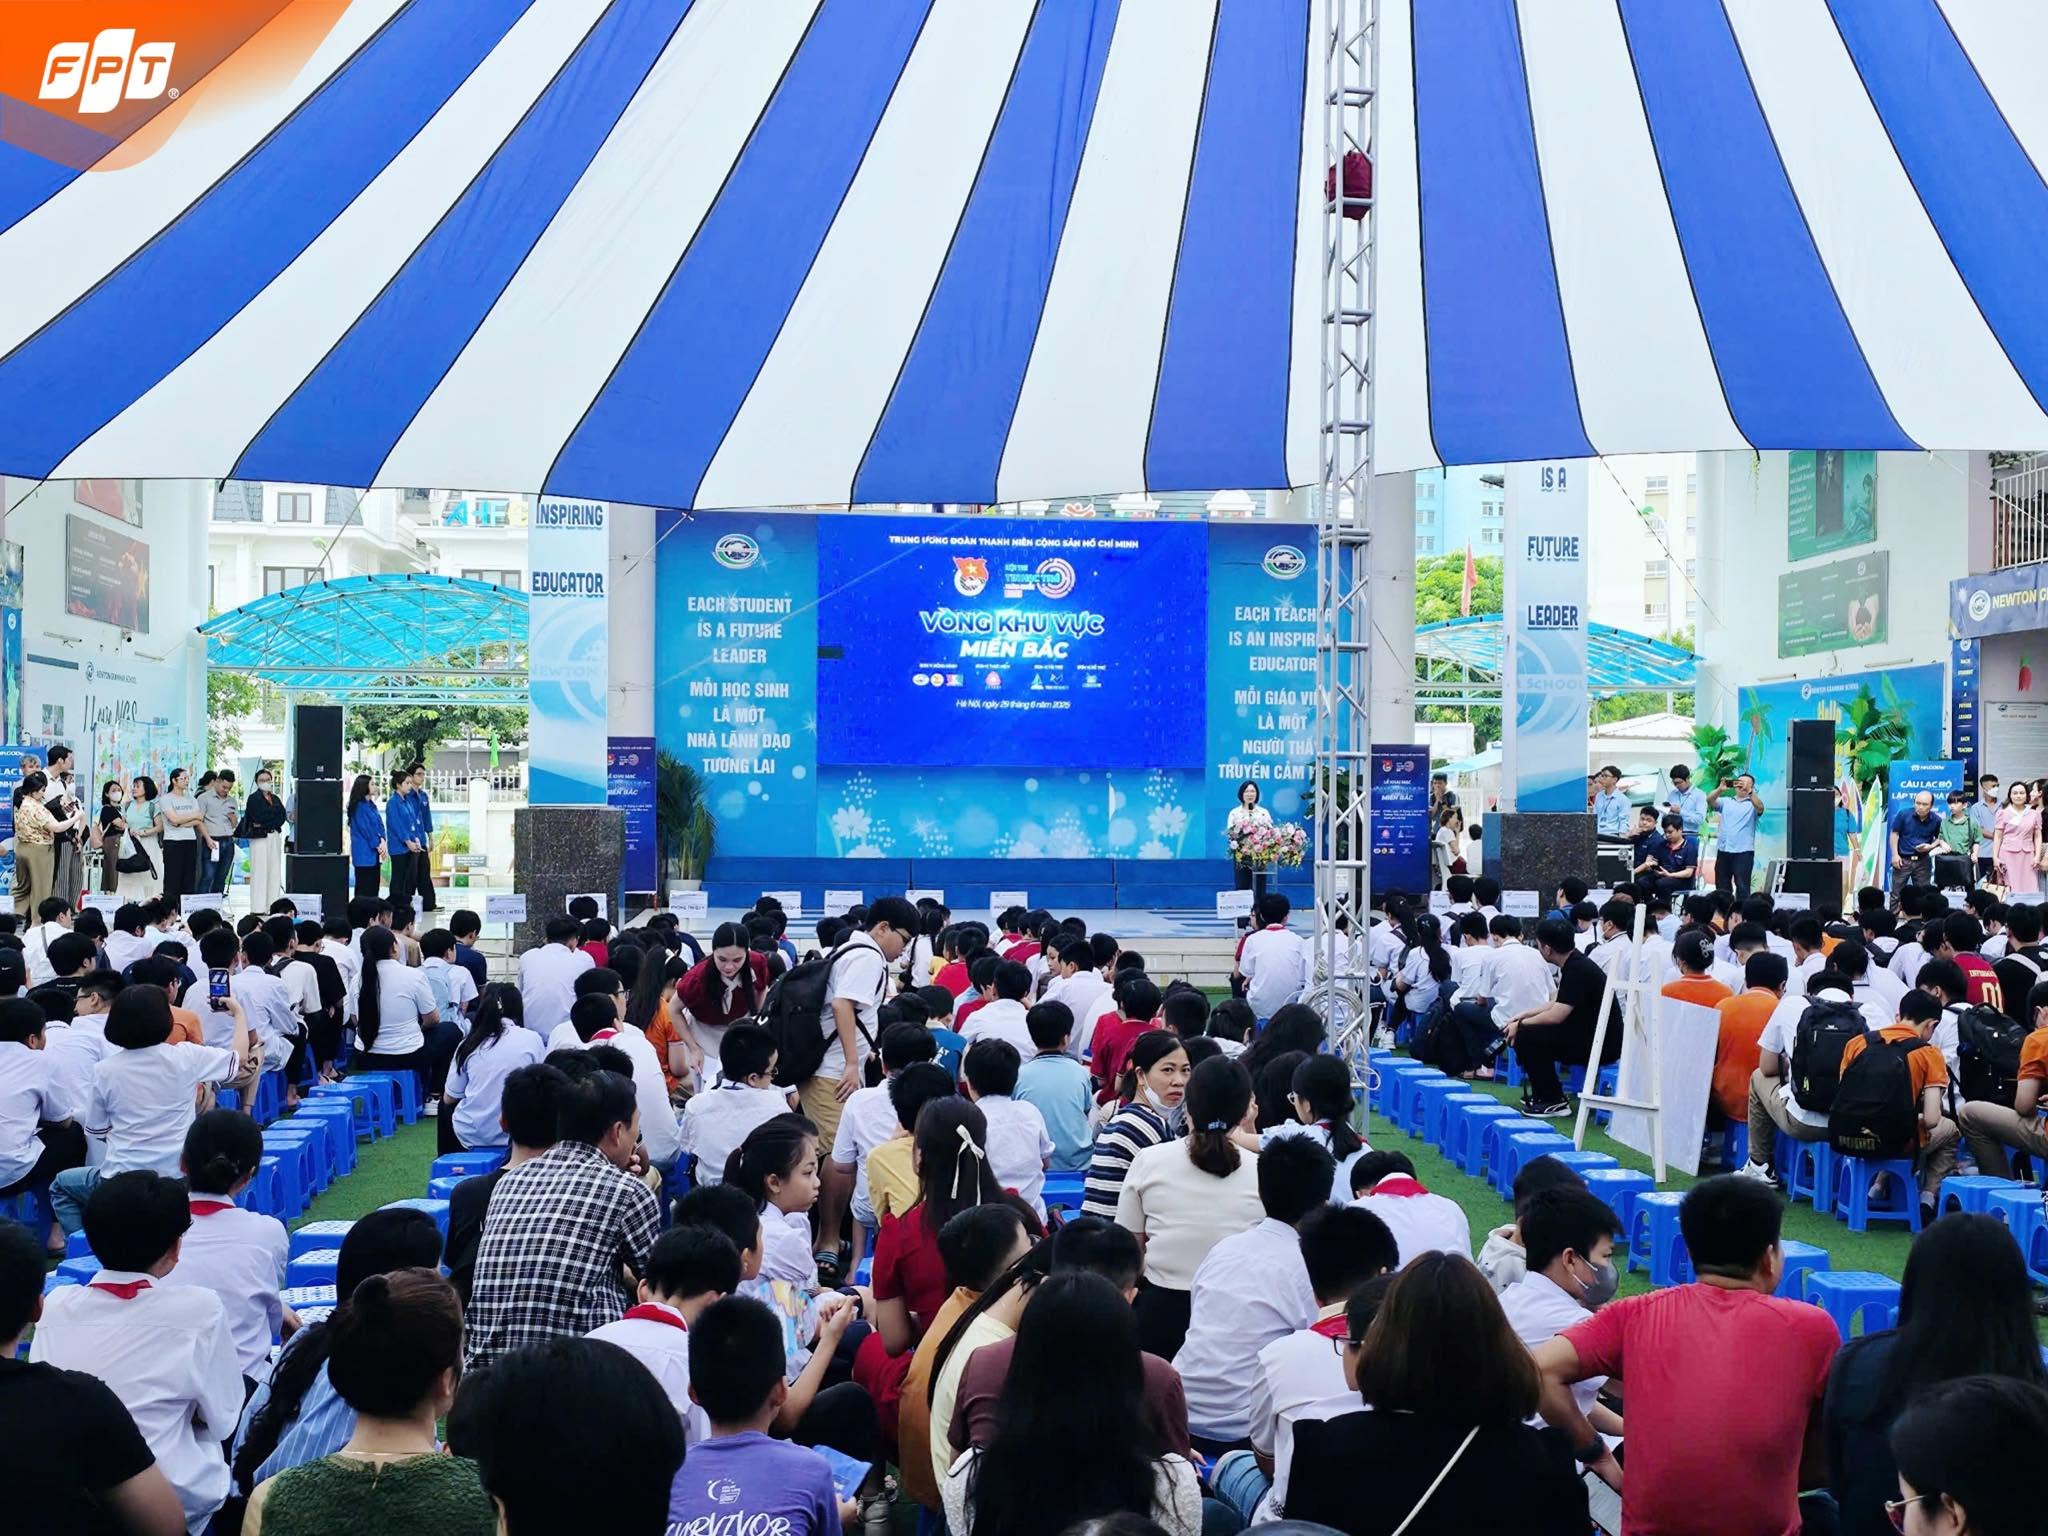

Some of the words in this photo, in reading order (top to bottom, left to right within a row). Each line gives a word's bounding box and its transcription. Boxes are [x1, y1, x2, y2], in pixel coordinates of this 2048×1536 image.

[1541, 467, 1553, 488] IS
[1558, 467, 1567, 488] A
[536, 503, 603, 526] INSPIRING
[1528, 536, 1579, 557] FUTURE
[532, 571, 604, 594] EDUCATOR
[688, 597, 725, 613] EACH
[729, 597, 792, 614] STUDENT
[1992, 589, 2037, 608] NEWTON
[919, 607, 991, 635] VÒNG
[998, 610, 1049, 634] KHU
[1053, 608, 1105, 639] VỰC
[1235, 607, 1270, 621] EACH
[1274, 607, 1332, 622] TEACHR
[1528, 605, 1578, 626] LEADER
[698, 621, 712, 638] IS
[716, 623, 726, 638] A
[730, 623, 782, 639] FUTURE
[1229, 632, 1242, 646] IS
[1246, 632, 1265, 646] AN
[713, 648, 766, 664] LEADER
[959, 637, 1017, 659] MIỀN
[1021, 636, 1069, 659] BẮC
[1250, 656, 1317, 672] EDUCATOR
[690, 677, 718, 697] MỖI
[722, 682, 751, 701] HỌC
[755, 682, 789, 698] SINH
[1235, 685, 1260, 705] MỖI
[1265, 688, 1296, 705] GIÁO
[714, 704, 732, 723] LÀ
[735, 704, 766, 726] MỘT
[1258, 712, 1274, 730] LÀ
[1278, 713, 1308, 733] MỘT
[687, 729, 718, 748] NHÀ
[721, 729, 759, 749] LÃNH
[763, 732, 791, 752] ĐẠO
[1243, 736, 1284, 755] NGƯỜI
[702, 757, 750, 774] TƯƠNG
[753, 759, 775, 774] LAI
[1218, 760, 1270, 779] TRUYỀN
[1274, 760, 1305, 779] CẢM
